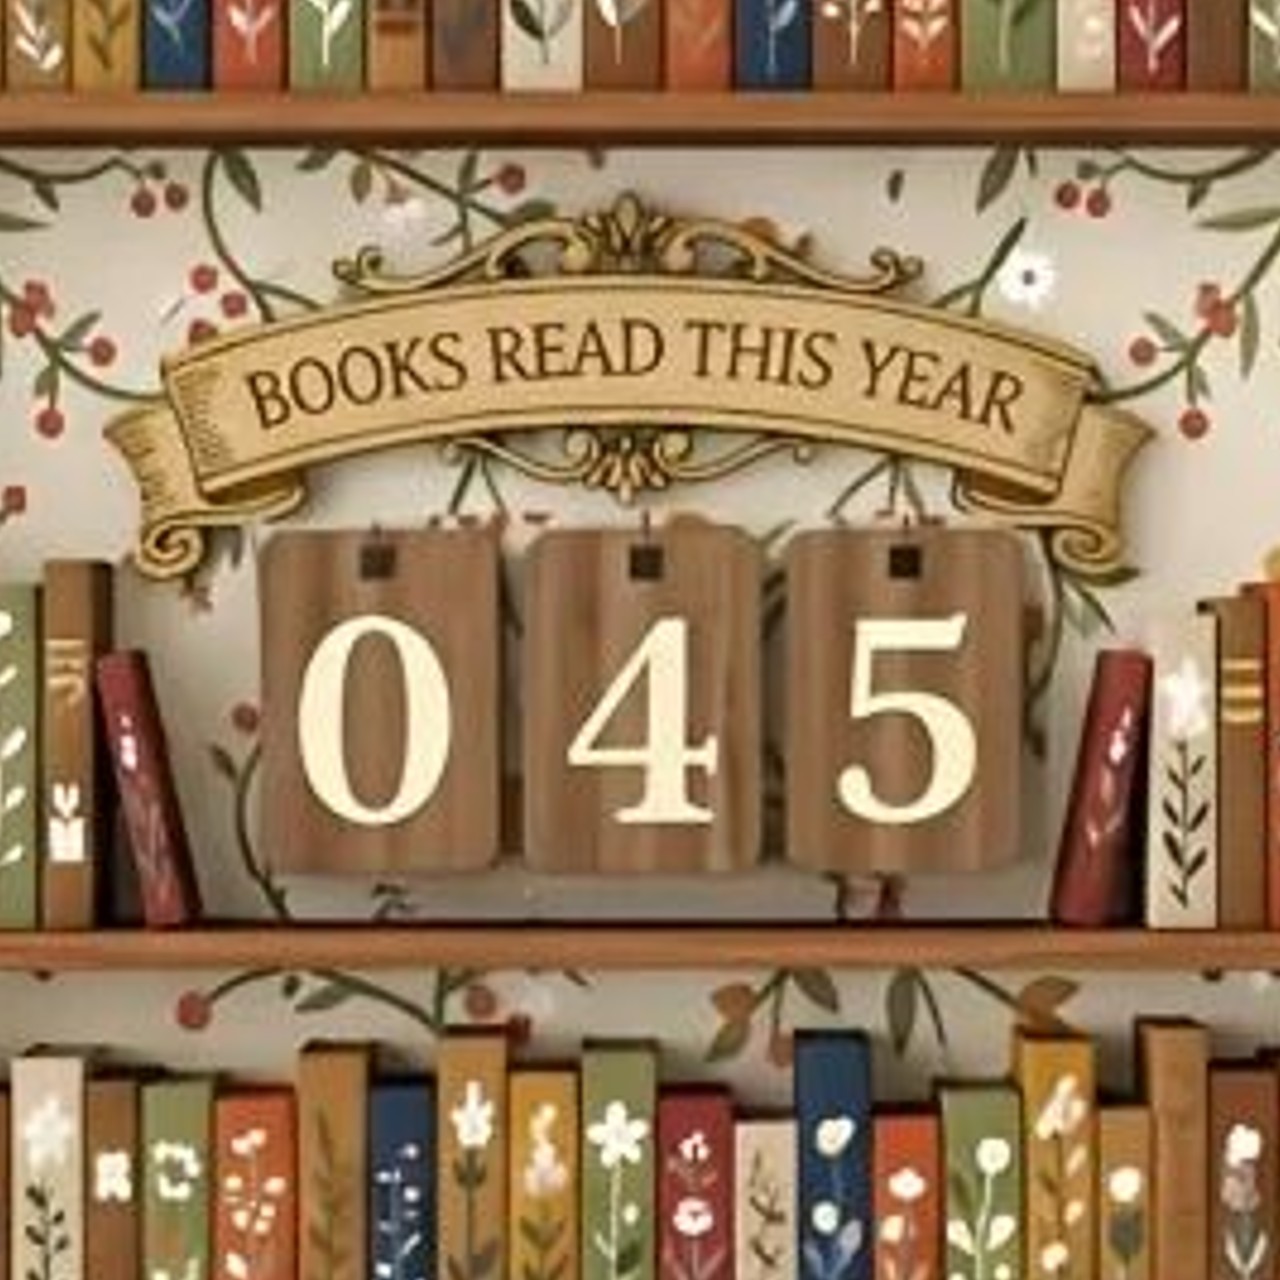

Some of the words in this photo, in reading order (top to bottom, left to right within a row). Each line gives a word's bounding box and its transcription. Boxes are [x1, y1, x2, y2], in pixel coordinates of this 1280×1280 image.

[243, 331, 469, 430] BOOKS
[487, 318, 666, 384] READ
[685, 319, 837, 390] THIS
[861, 338, 1025, 434] YEAR
